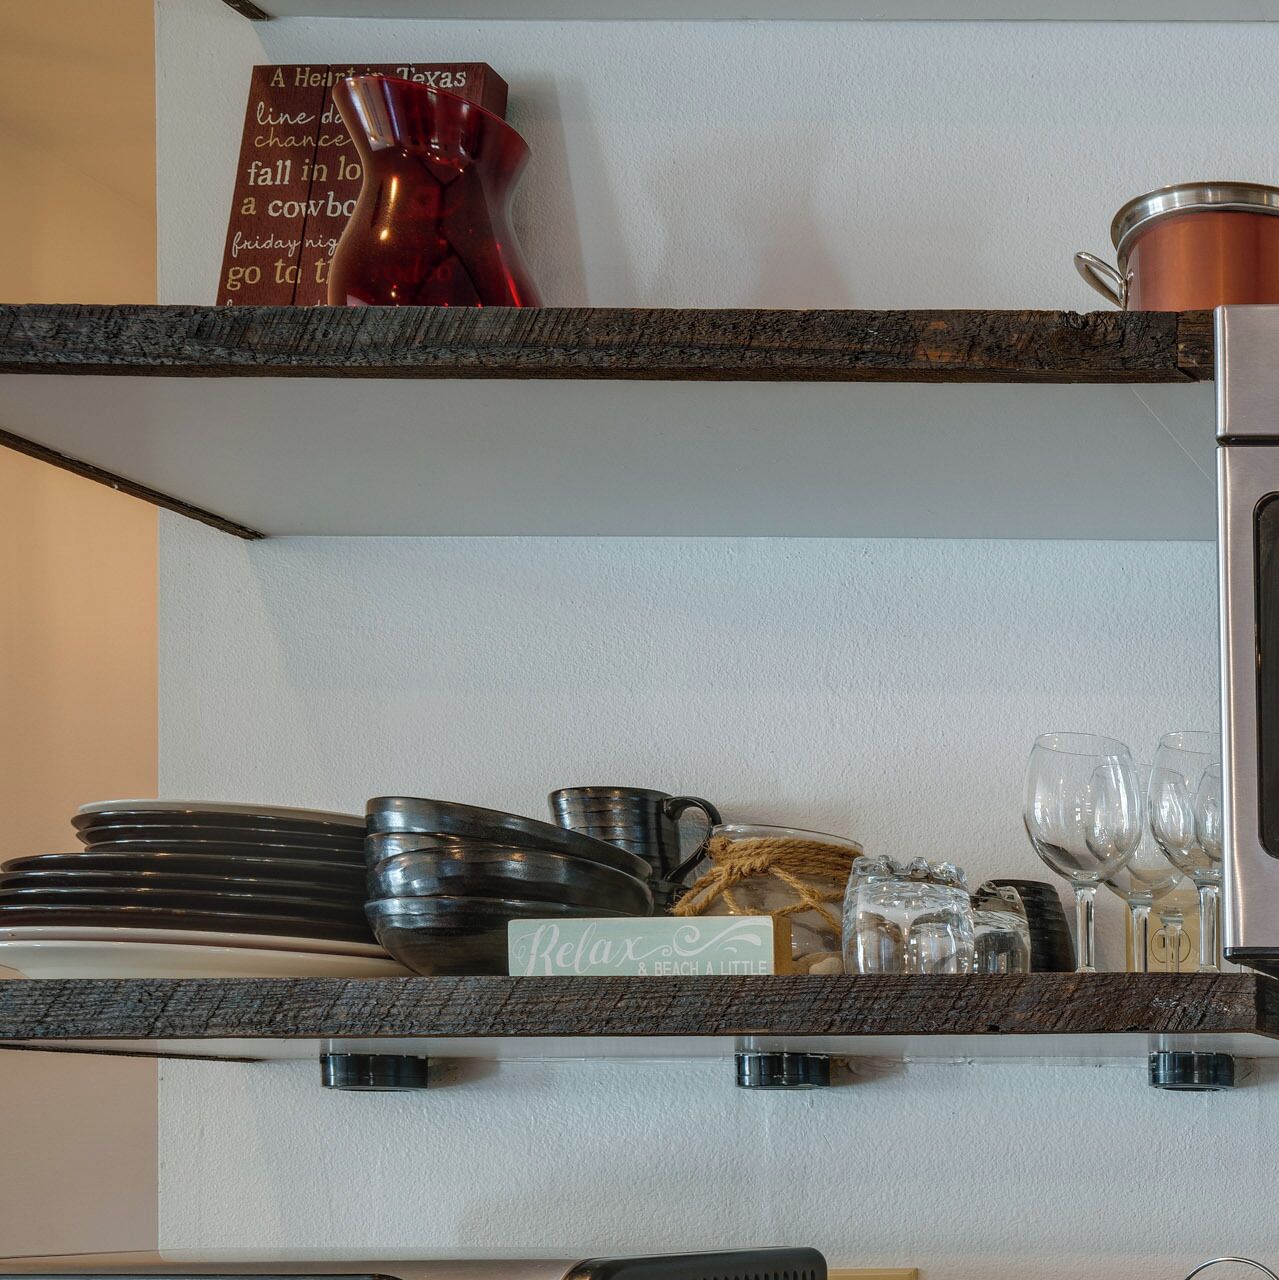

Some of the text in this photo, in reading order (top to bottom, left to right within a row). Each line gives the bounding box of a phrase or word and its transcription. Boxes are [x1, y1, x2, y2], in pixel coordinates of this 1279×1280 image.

[270, 67, 285, 87] A
[396, 67, 467, 88] Texas
[256, 101, 316, 125] line
[247, 159, 291, 186] fall
[300, 160, 327, 182] in
[241, 197, 257, 215] a
[232, 231, 301, 257] friday
[226, 266, 261, 290] go
[274, 259, 302, 284] to
[512, 922, 648, 976] Relax
[638, 960, 767, 976] & BEACH A LITTLE
